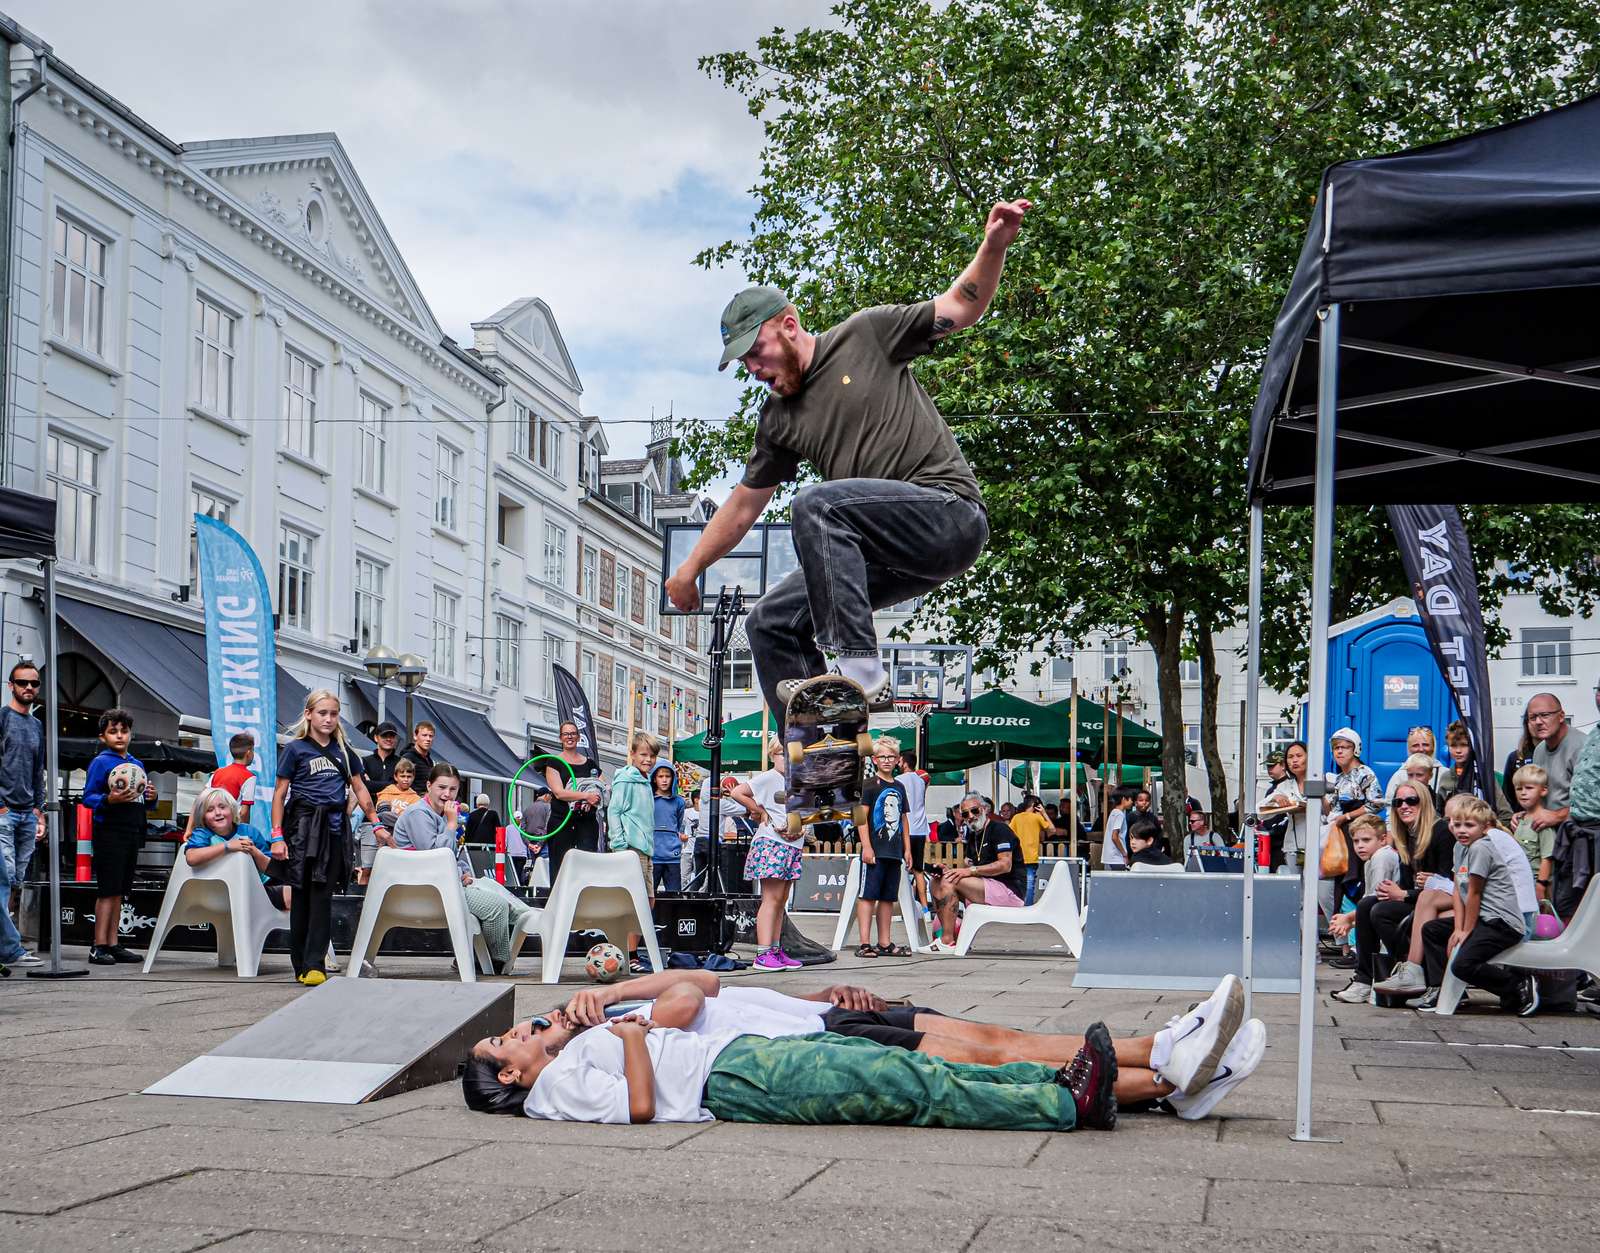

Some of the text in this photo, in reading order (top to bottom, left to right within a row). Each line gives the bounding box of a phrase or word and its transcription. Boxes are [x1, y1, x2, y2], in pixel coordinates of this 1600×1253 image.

[953, 716, 1031, 727] TUBORG
[818, 874, 848, 886] BAS
[679, 921, 695, 934] EXIT
